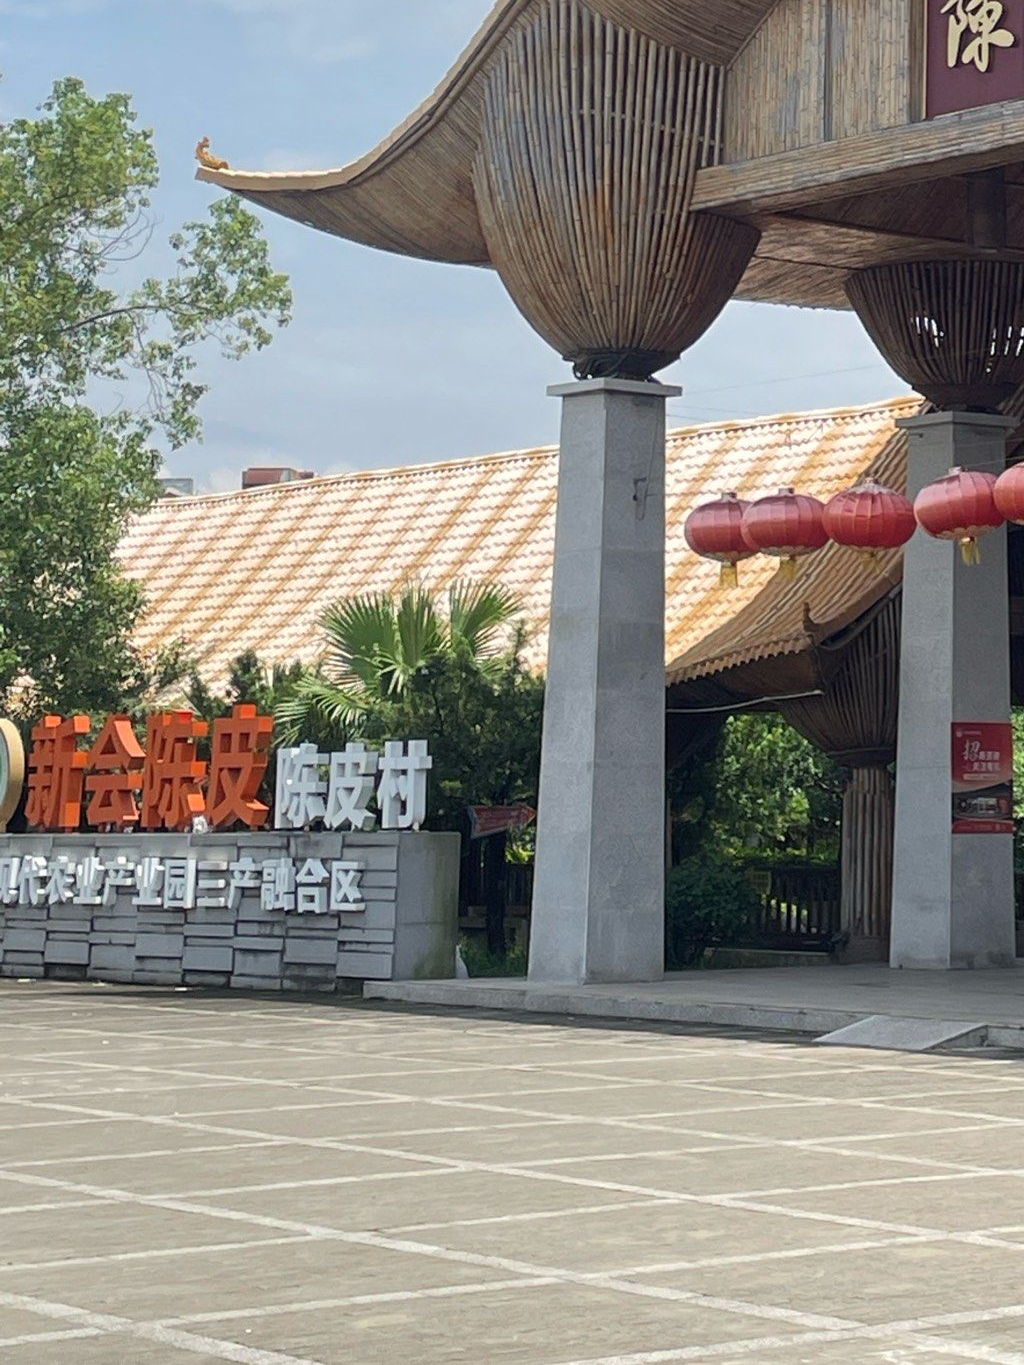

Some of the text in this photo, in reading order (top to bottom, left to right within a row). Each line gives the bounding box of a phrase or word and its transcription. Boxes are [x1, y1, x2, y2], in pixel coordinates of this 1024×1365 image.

[24, 703, 433, 831] 新会陈皮 陈皮村
